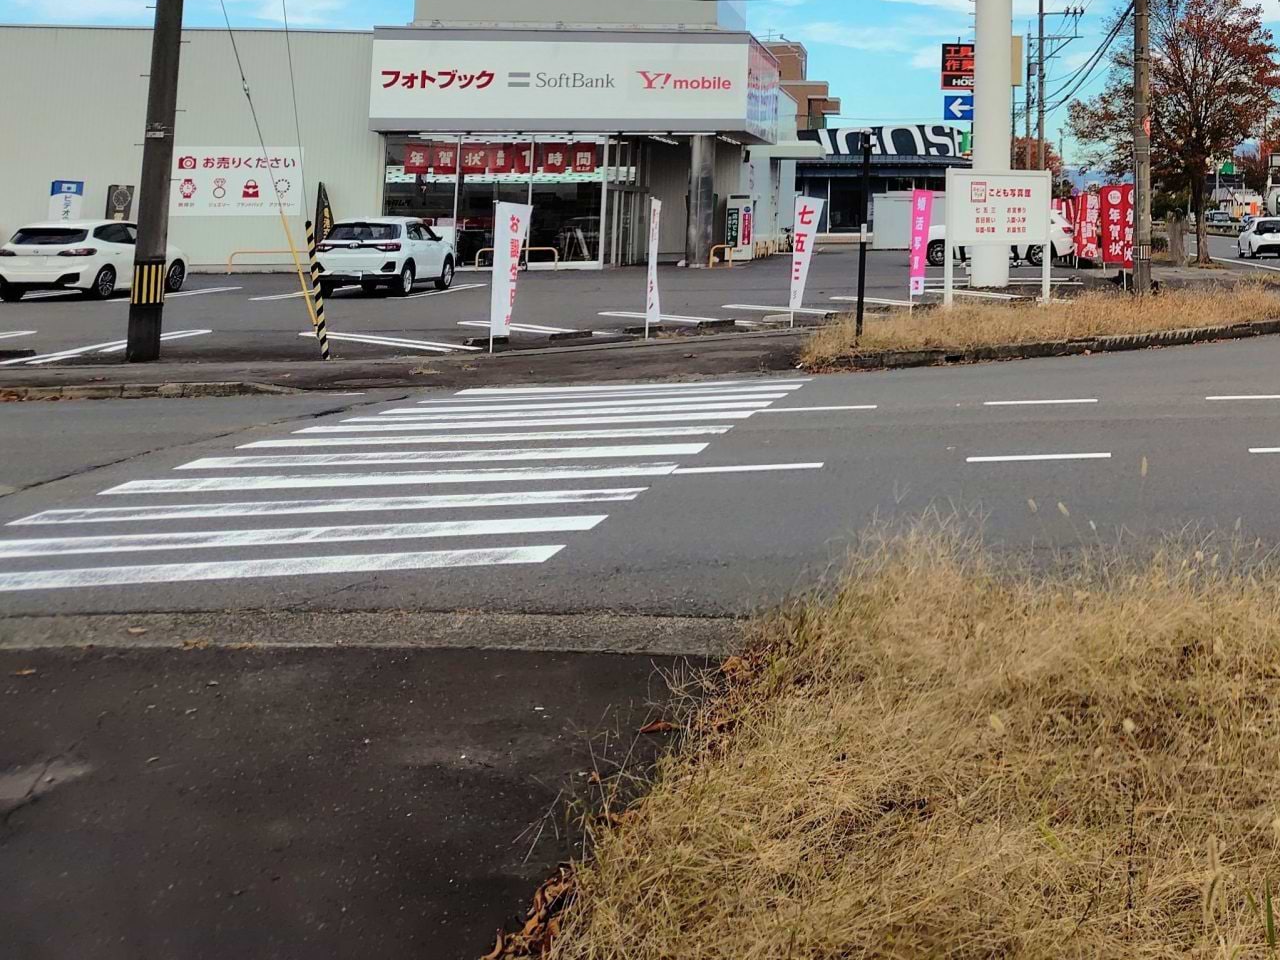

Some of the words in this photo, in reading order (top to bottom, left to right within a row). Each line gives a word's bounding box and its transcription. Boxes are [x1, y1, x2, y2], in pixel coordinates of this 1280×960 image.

[381, 69, 495, 90] フォトブック
[535, 71, 615, 89] SoftBank
[202, 157, 296, 169] お売りください
[988, 188, 1031, 198] こども写真館
[1108, 207, 1124, 257] 年賀状
